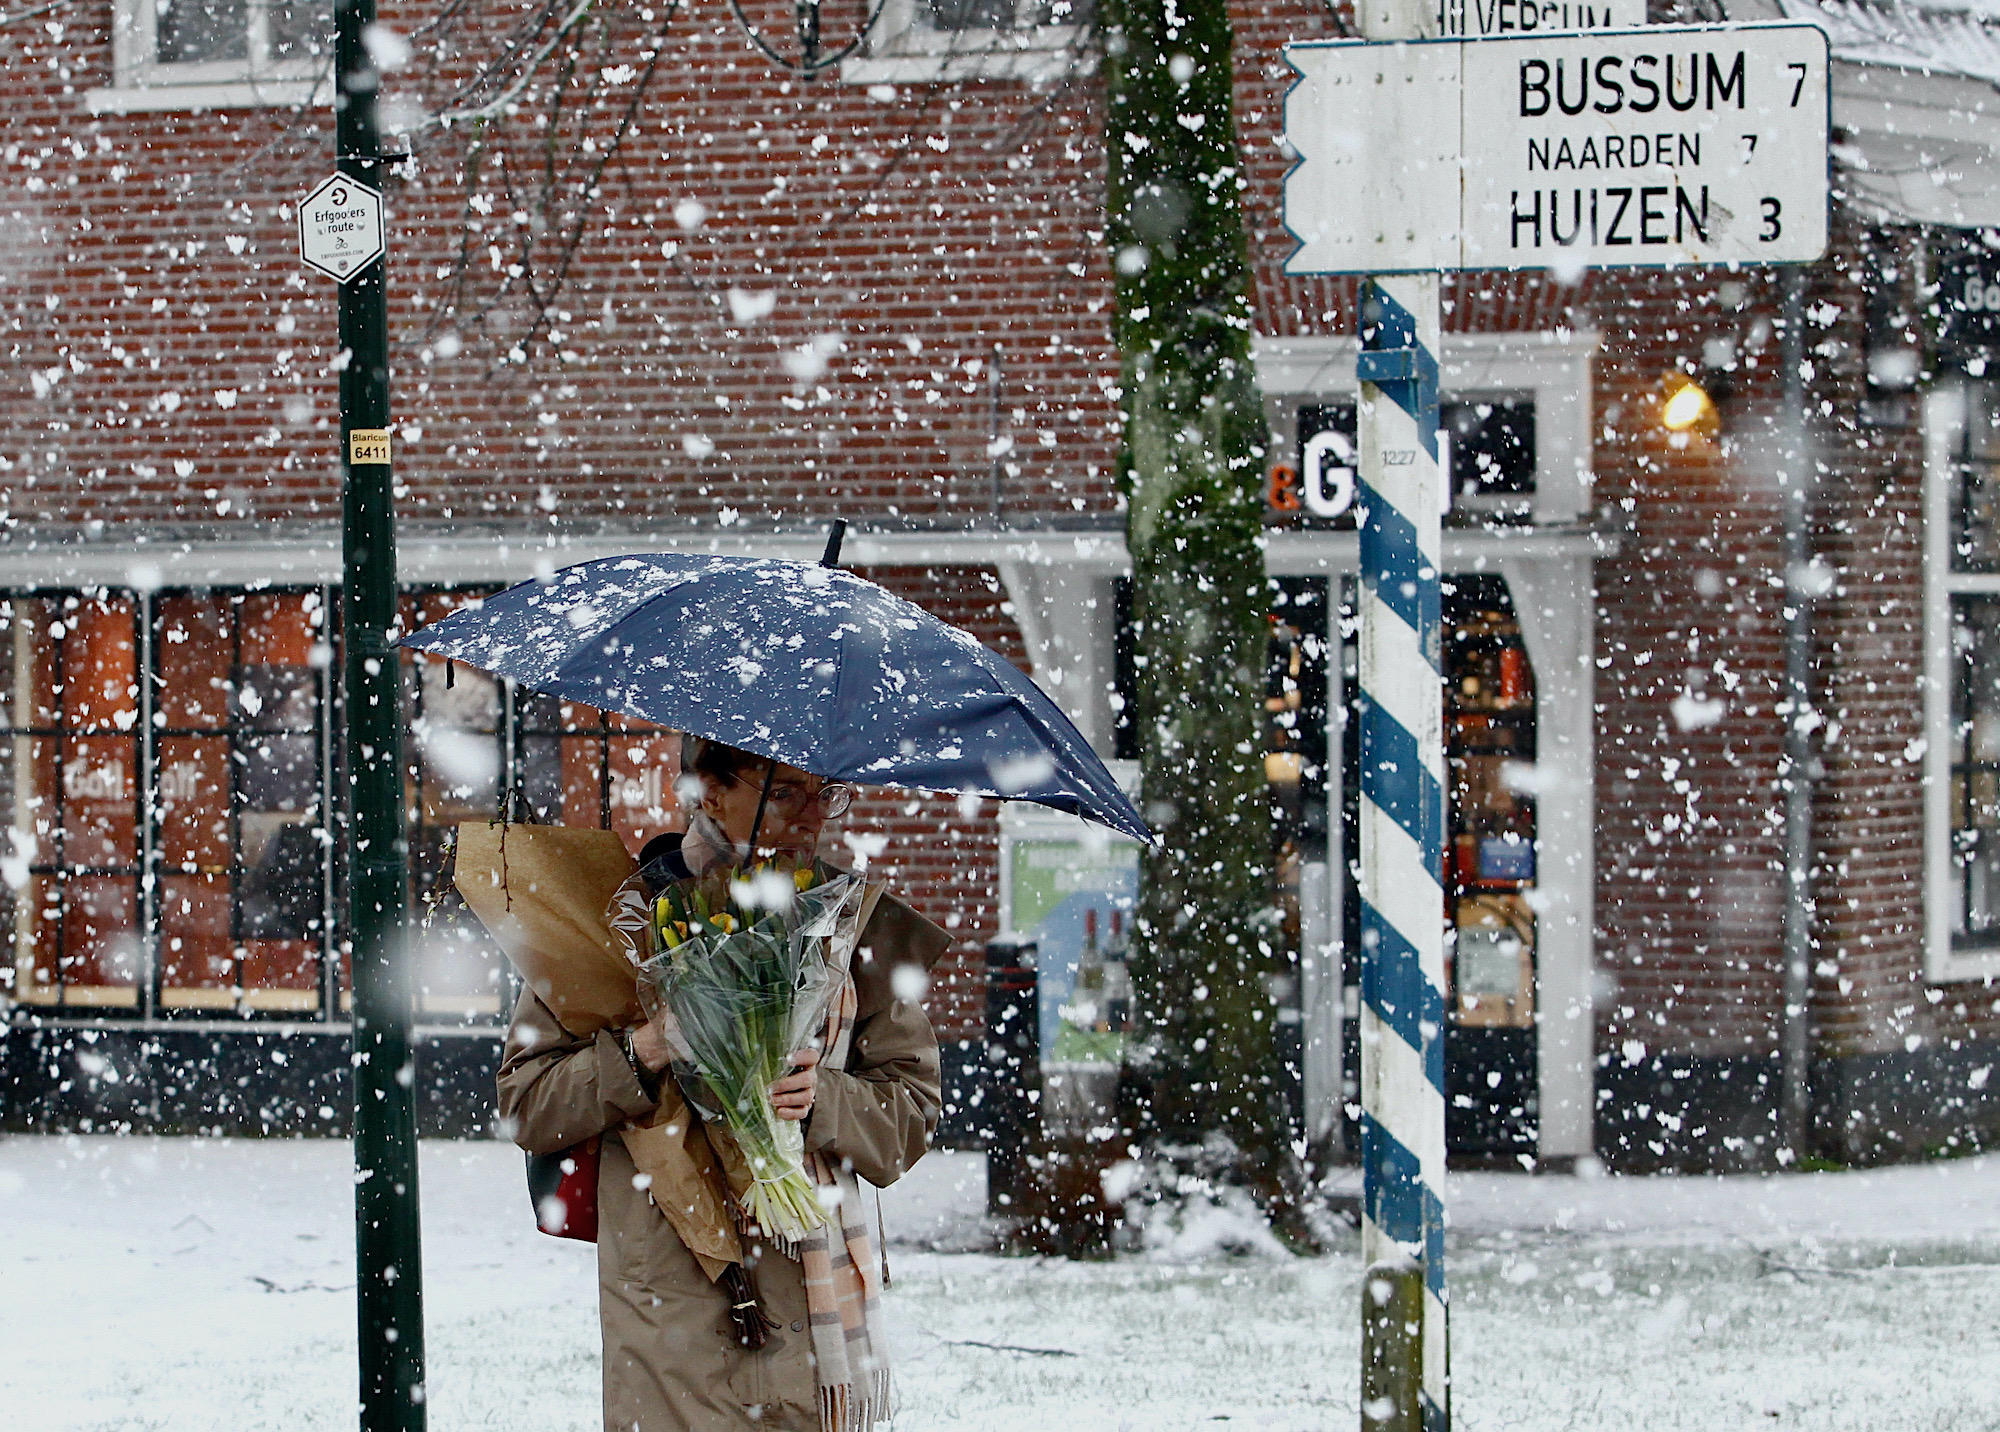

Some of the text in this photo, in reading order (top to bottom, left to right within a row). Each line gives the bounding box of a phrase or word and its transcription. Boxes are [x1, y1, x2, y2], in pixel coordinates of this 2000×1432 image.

[1520, 51, 1807, 117] BUSSUM 7
[1528, 133, 1758, 171] NAARDEN 7
[328, 222, 354, 234] route
[1511, 186, 1782, 248] HUIZEN 3
[355, 446, 386, 459] 6411
[1381, 450, 1416, 466] 1227
